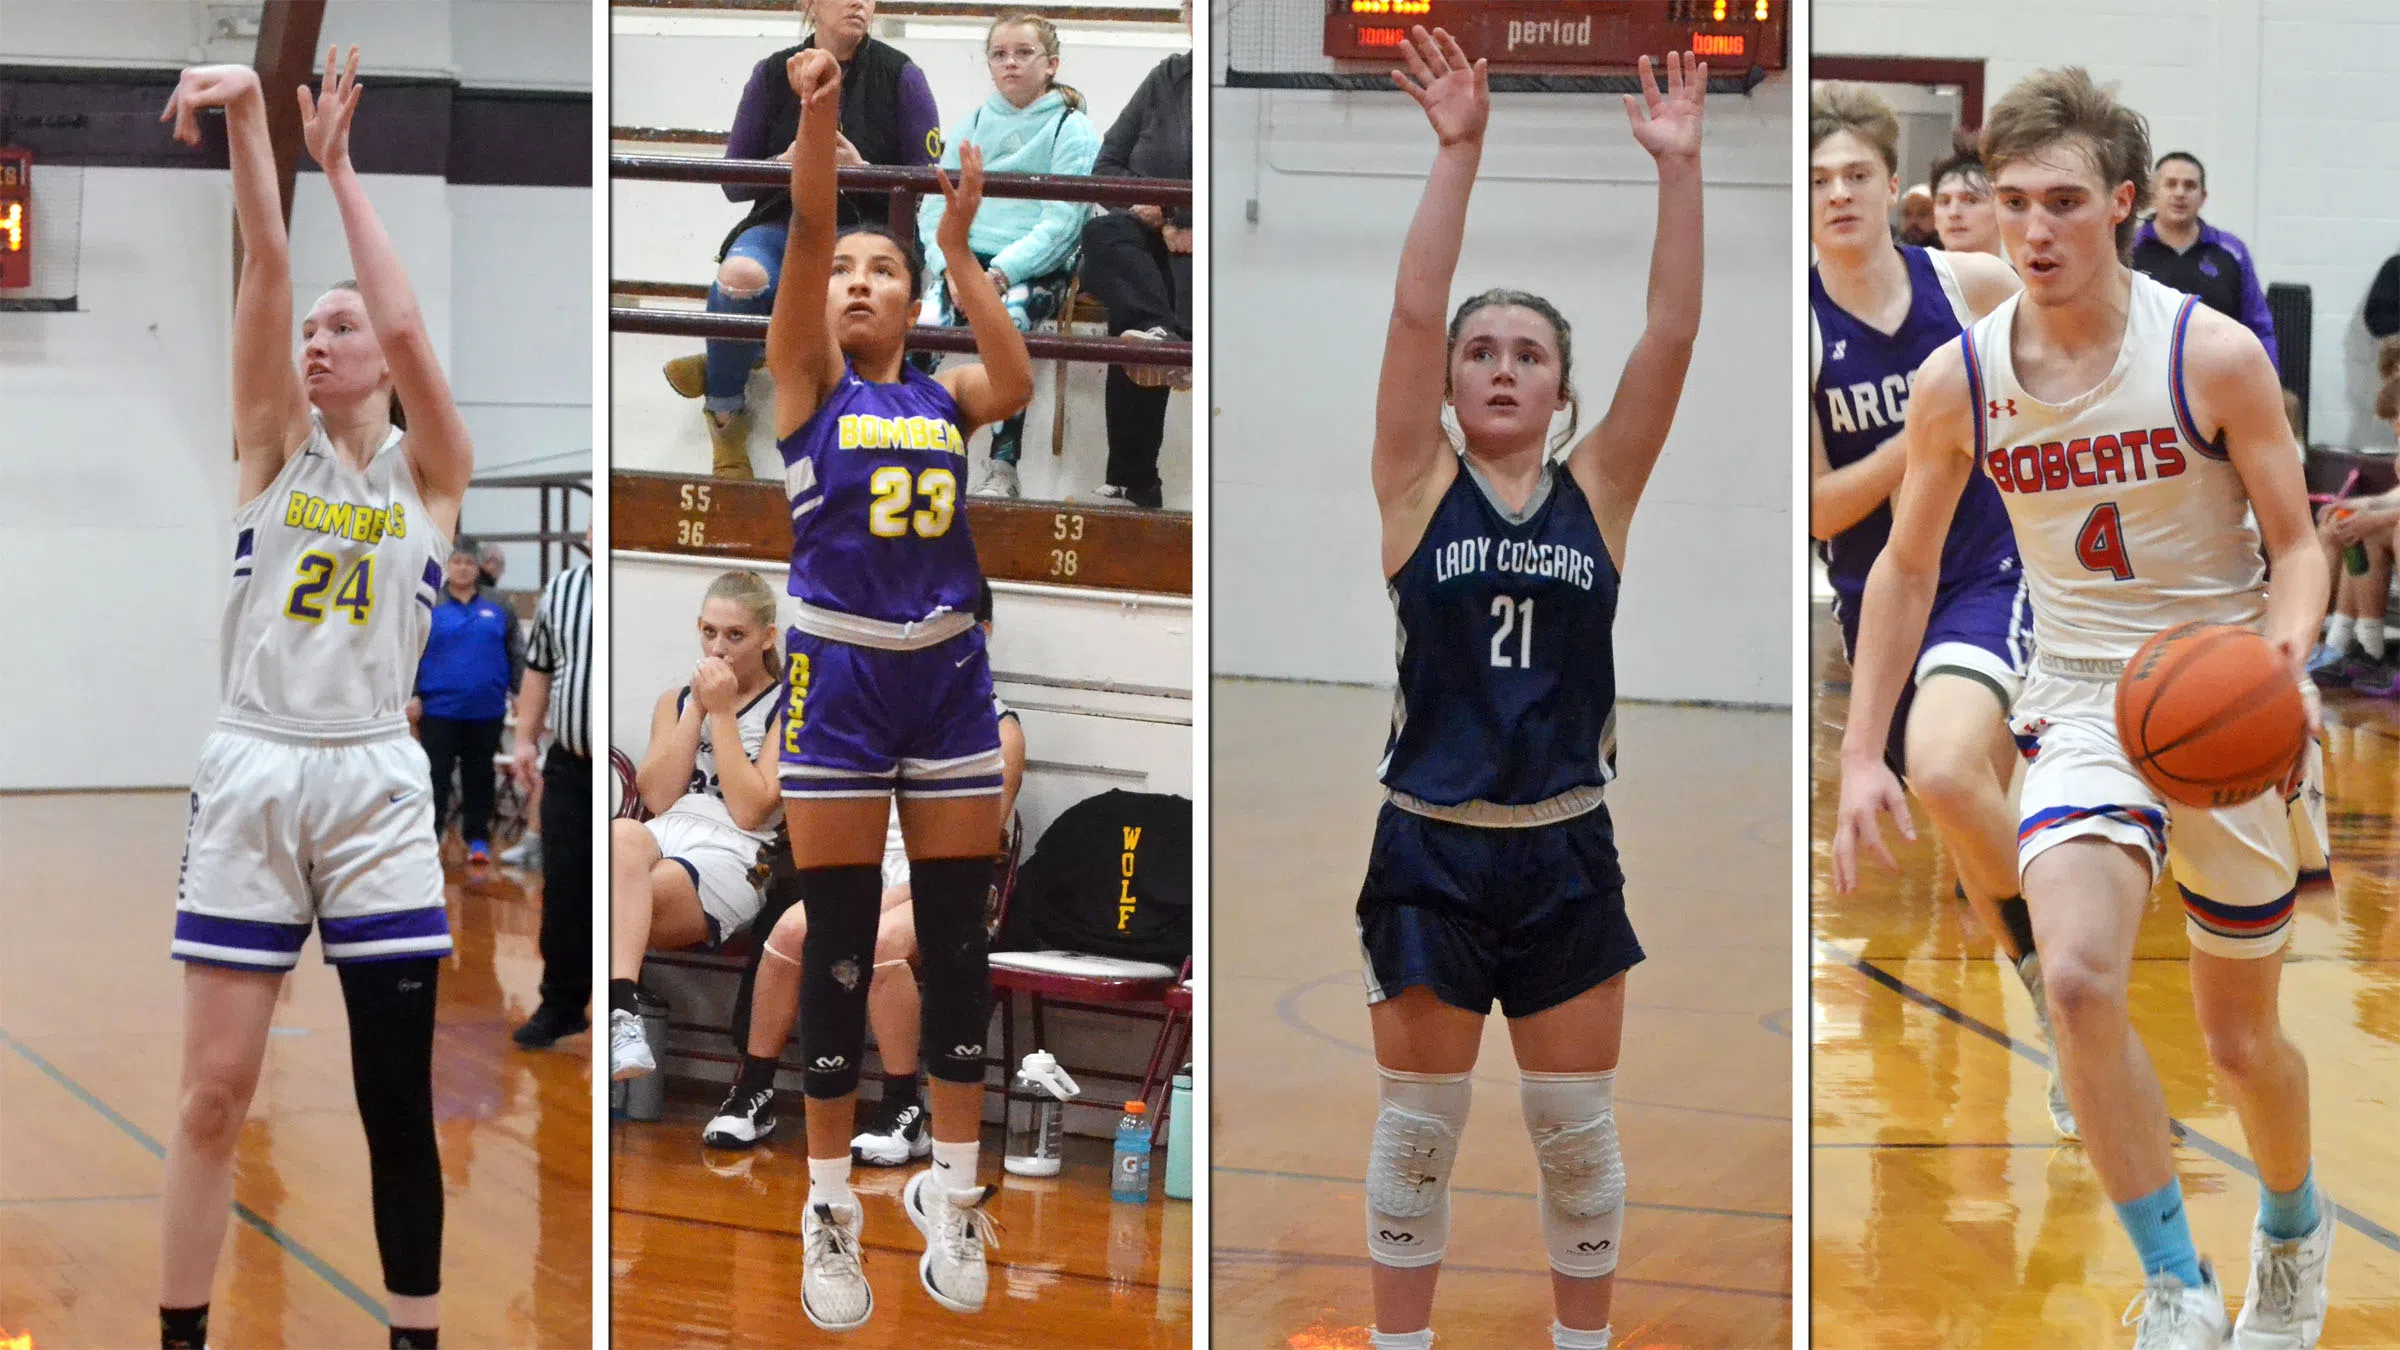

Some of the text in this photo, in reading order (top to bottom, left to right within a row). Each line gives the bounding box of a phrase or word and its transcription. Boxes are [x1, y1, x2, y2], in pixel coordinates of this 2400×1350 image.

[1508, 16, 1591, 51] period
[1692, 31, 1745, 56] bonus
[1825, 369, 1917, 433] ARC
[1987, 427, 2186, 494] BOBCATS
[680, 484, 711, 512] 55
[869, 466, 956, 538] 23
[1054, 513, 1084, 541] 53
[677, 519, 705, 547] 36
[1050, 548, 1078, 577] 38
[1436, 536, 1595, 591] LADY COUGARS
[2075, 502, 2135, 581] 4
[283, 549, 375, 626] 24
[1490, 594, 1534, 669] 21
[785, 652, 811, 754] BSE
[1117, 825, 1142, 930] WOLF
